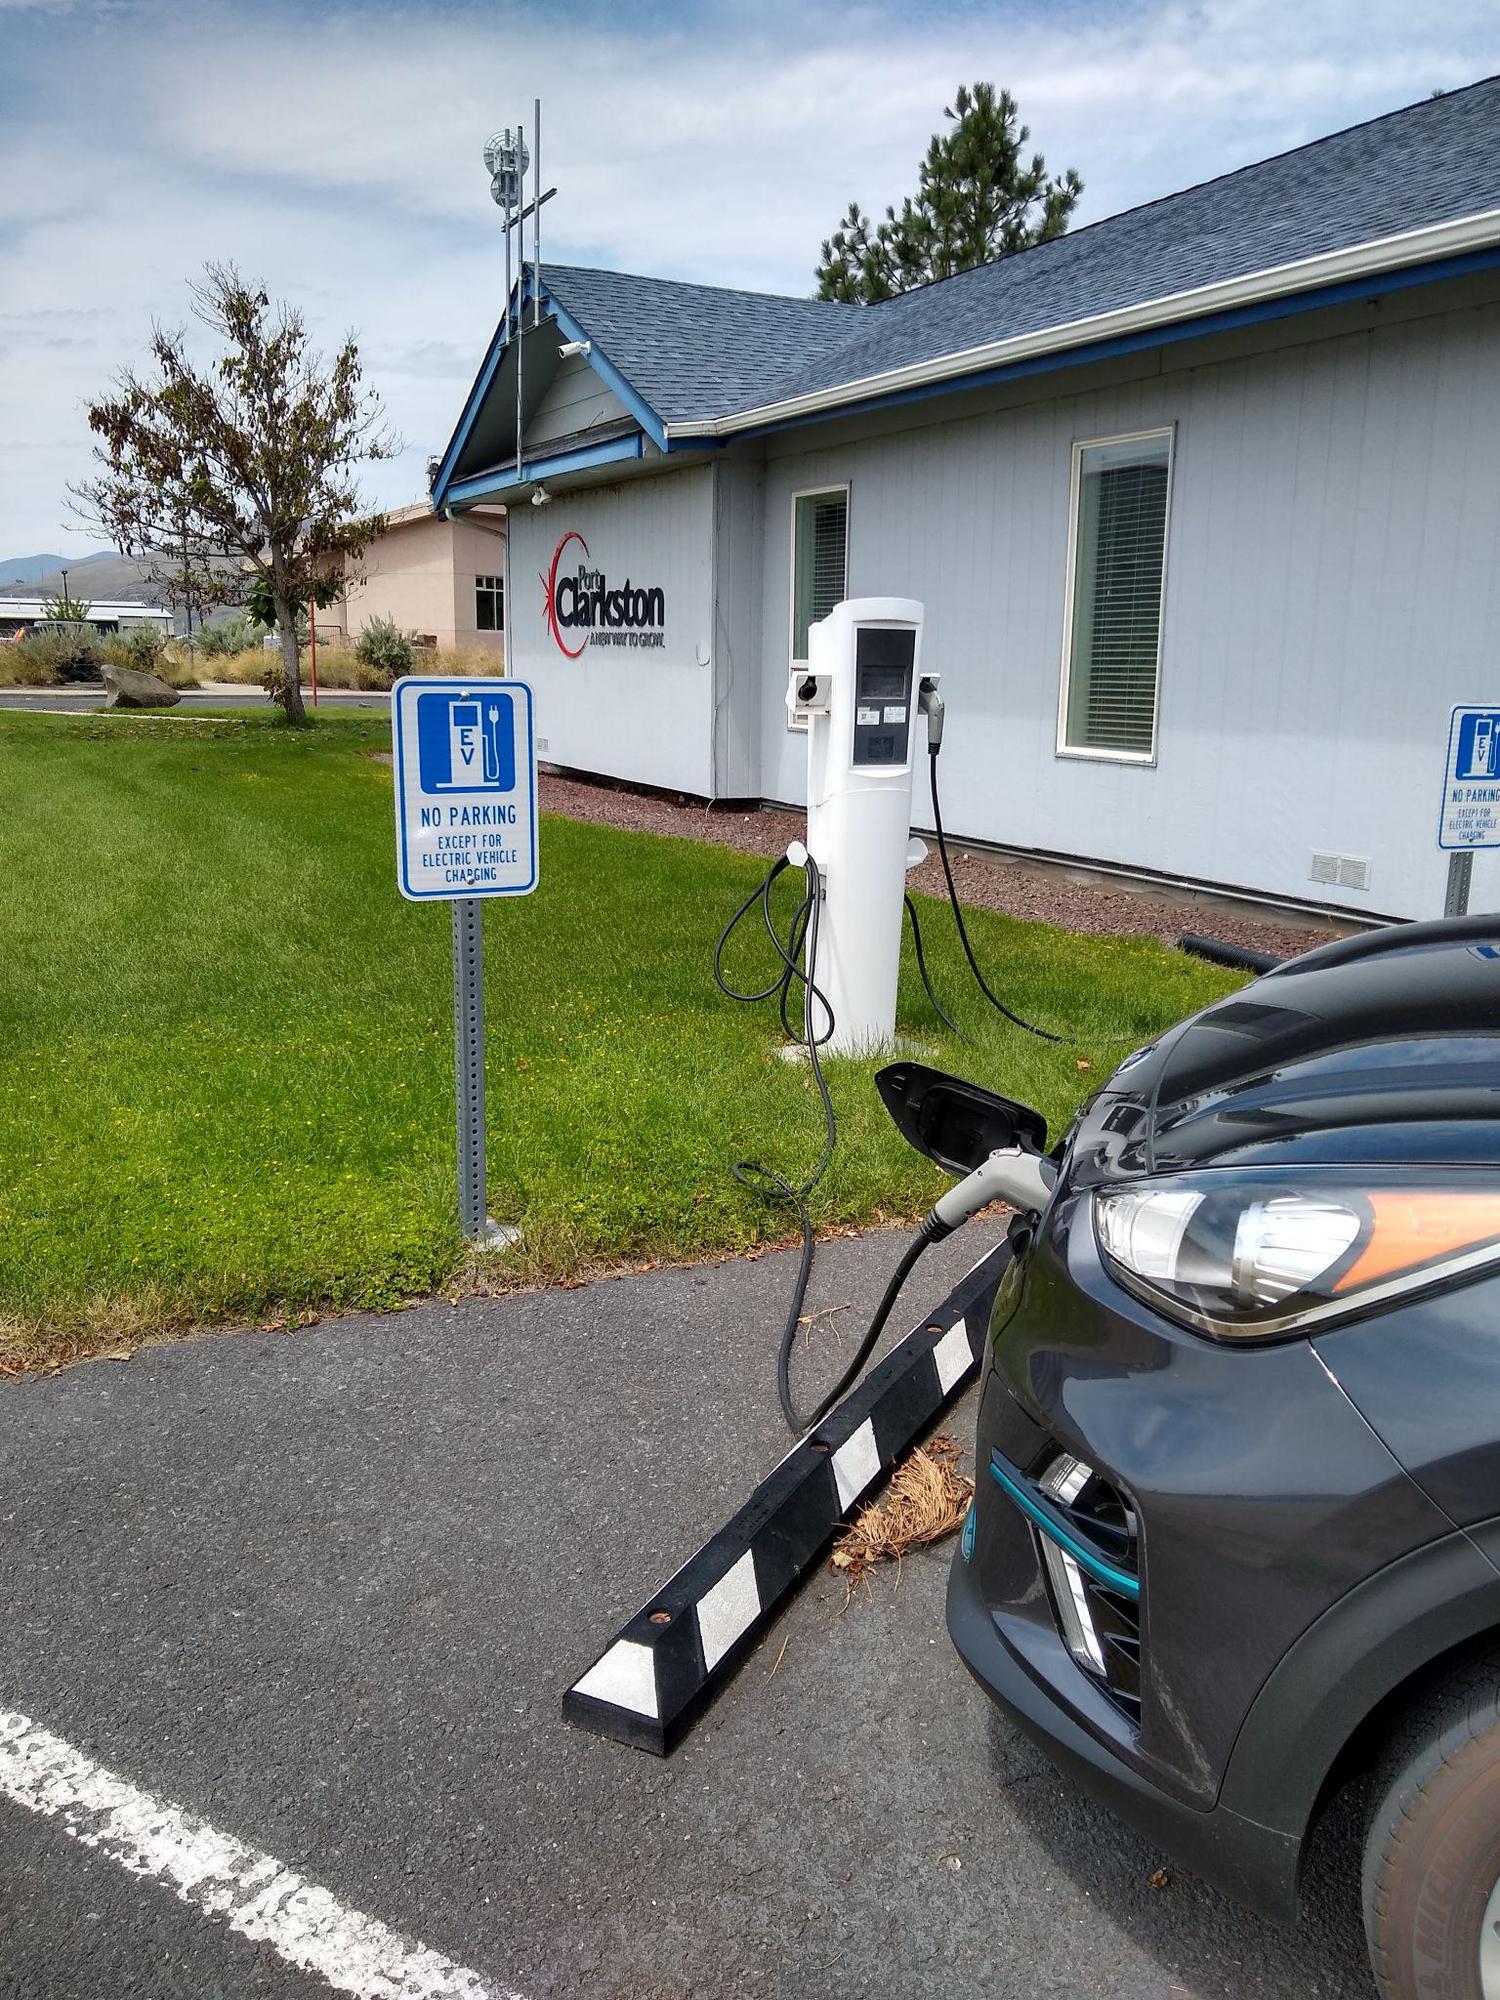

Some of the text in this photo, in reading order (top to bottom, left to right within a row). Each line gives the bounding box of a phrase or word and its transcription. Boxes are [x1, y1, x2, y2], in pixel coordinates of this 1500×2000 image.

[578, 565, 600, 590] Port
[556, 574, 665, 628] Clarkston
[628, 632, 638, 647] TO
[1452, 788, 1500, 802] NO PARKING
[421, 804, 517, 828] NO PARKING
[1458, 808, 1491, 818] EXCEPT FOR
[1449, 819, 1497, 830] ELECTRIC VEHICLE
[438, 833, 502, 850] EXCEPT FOR
[422, 849, 518, 867] ELECTRIC VEHICLE
[445, 867, 497, 883] CHARGING
